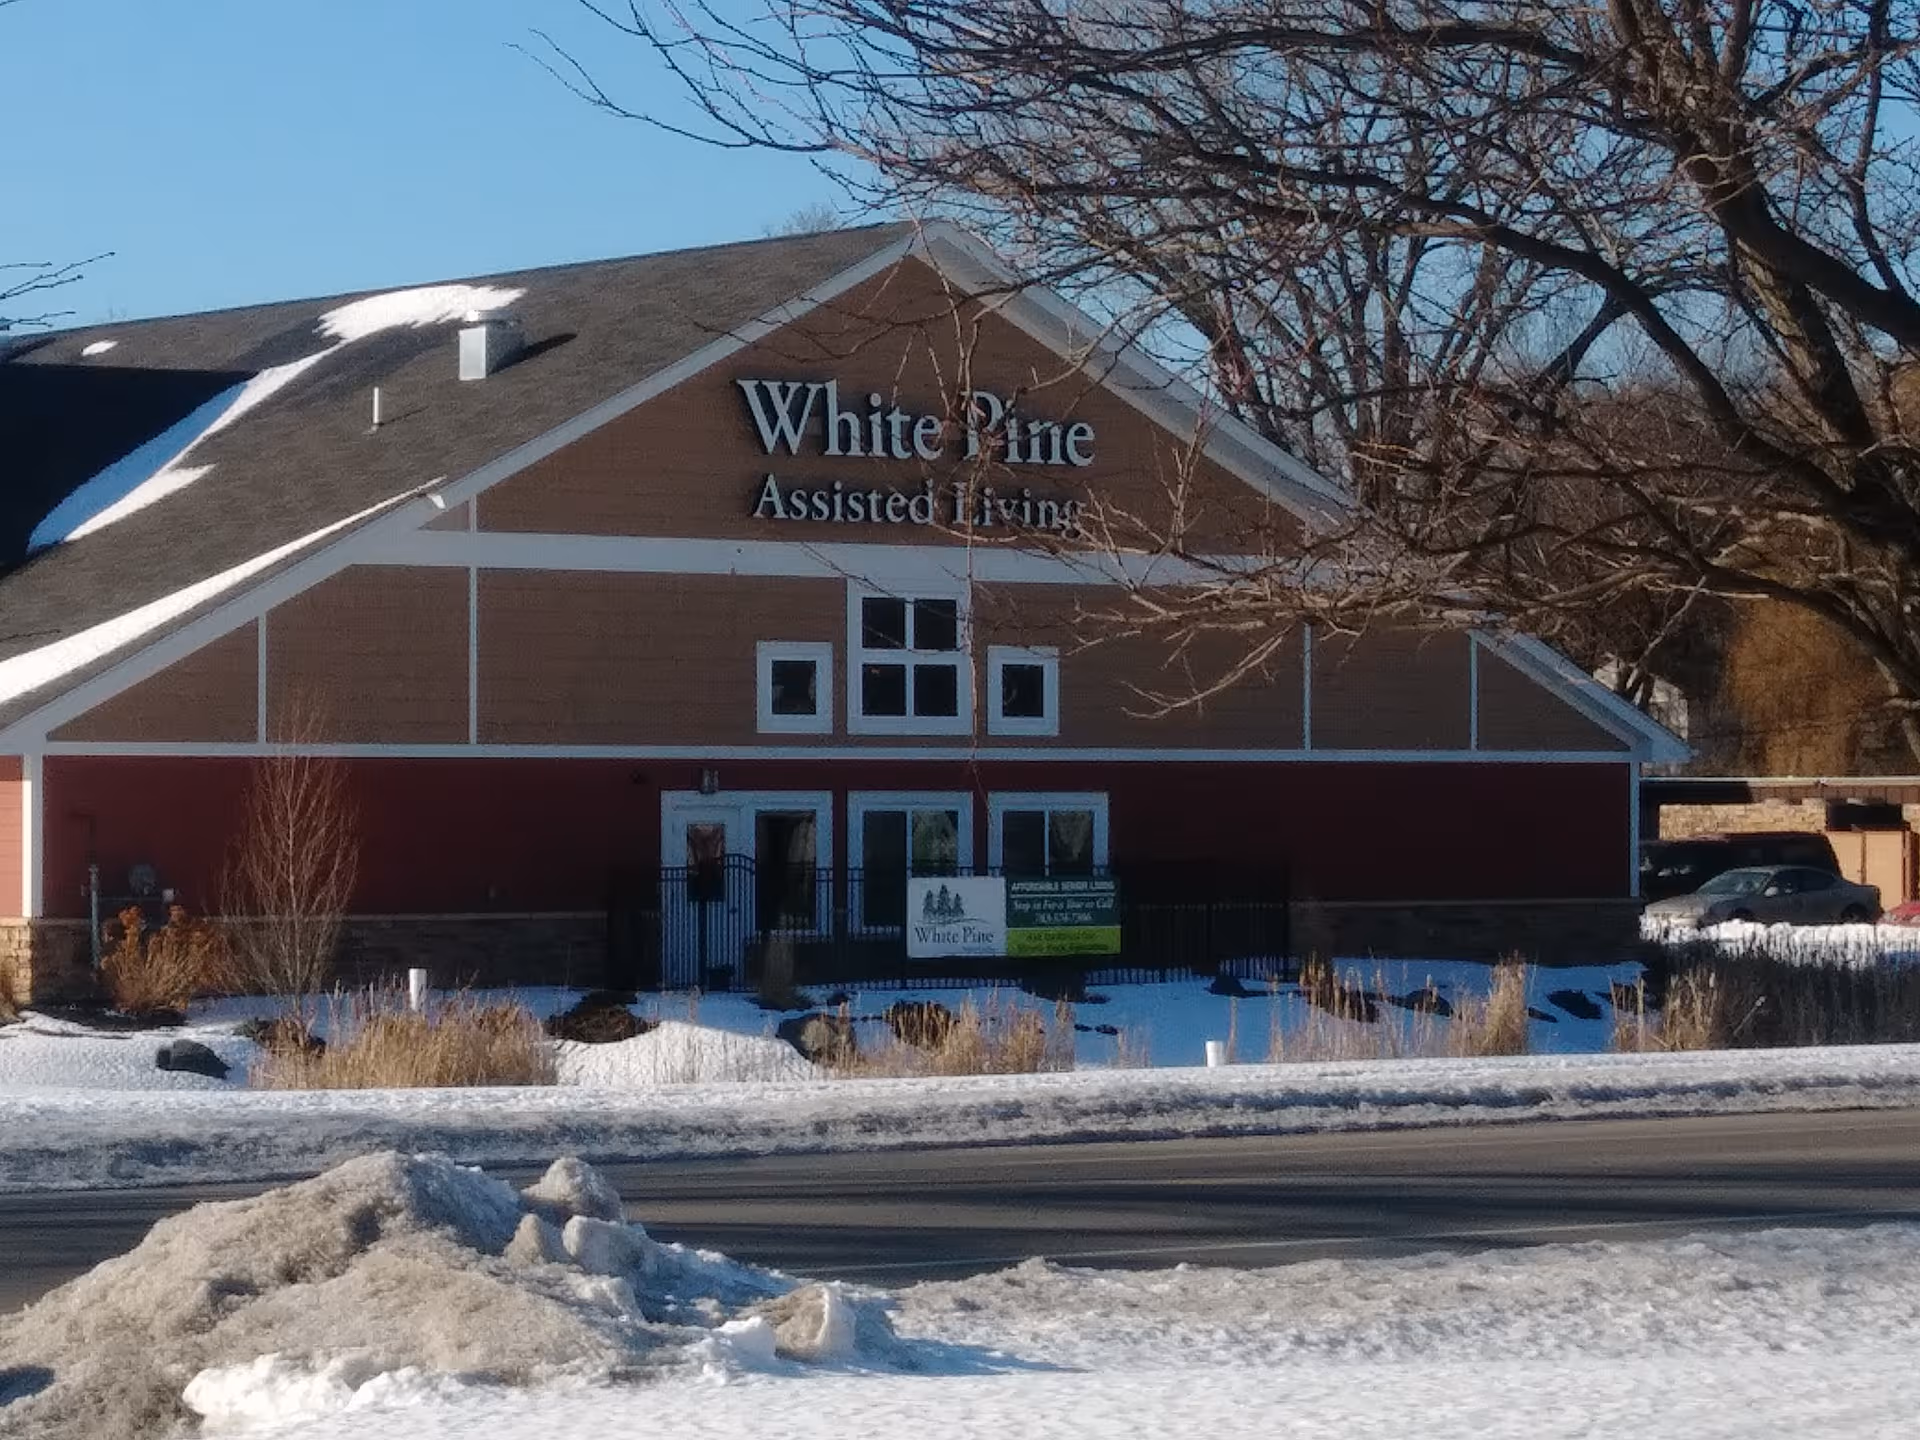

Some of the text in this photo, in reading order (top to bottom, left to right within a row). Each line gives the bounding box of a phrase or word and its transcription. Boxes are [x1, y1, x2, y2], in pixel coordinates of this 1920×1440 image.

[736, 378, 1095, 466] White Pine
[753, 473, 1086, 540] Assisted Living
[914, 926, 993, 944] White Pine
